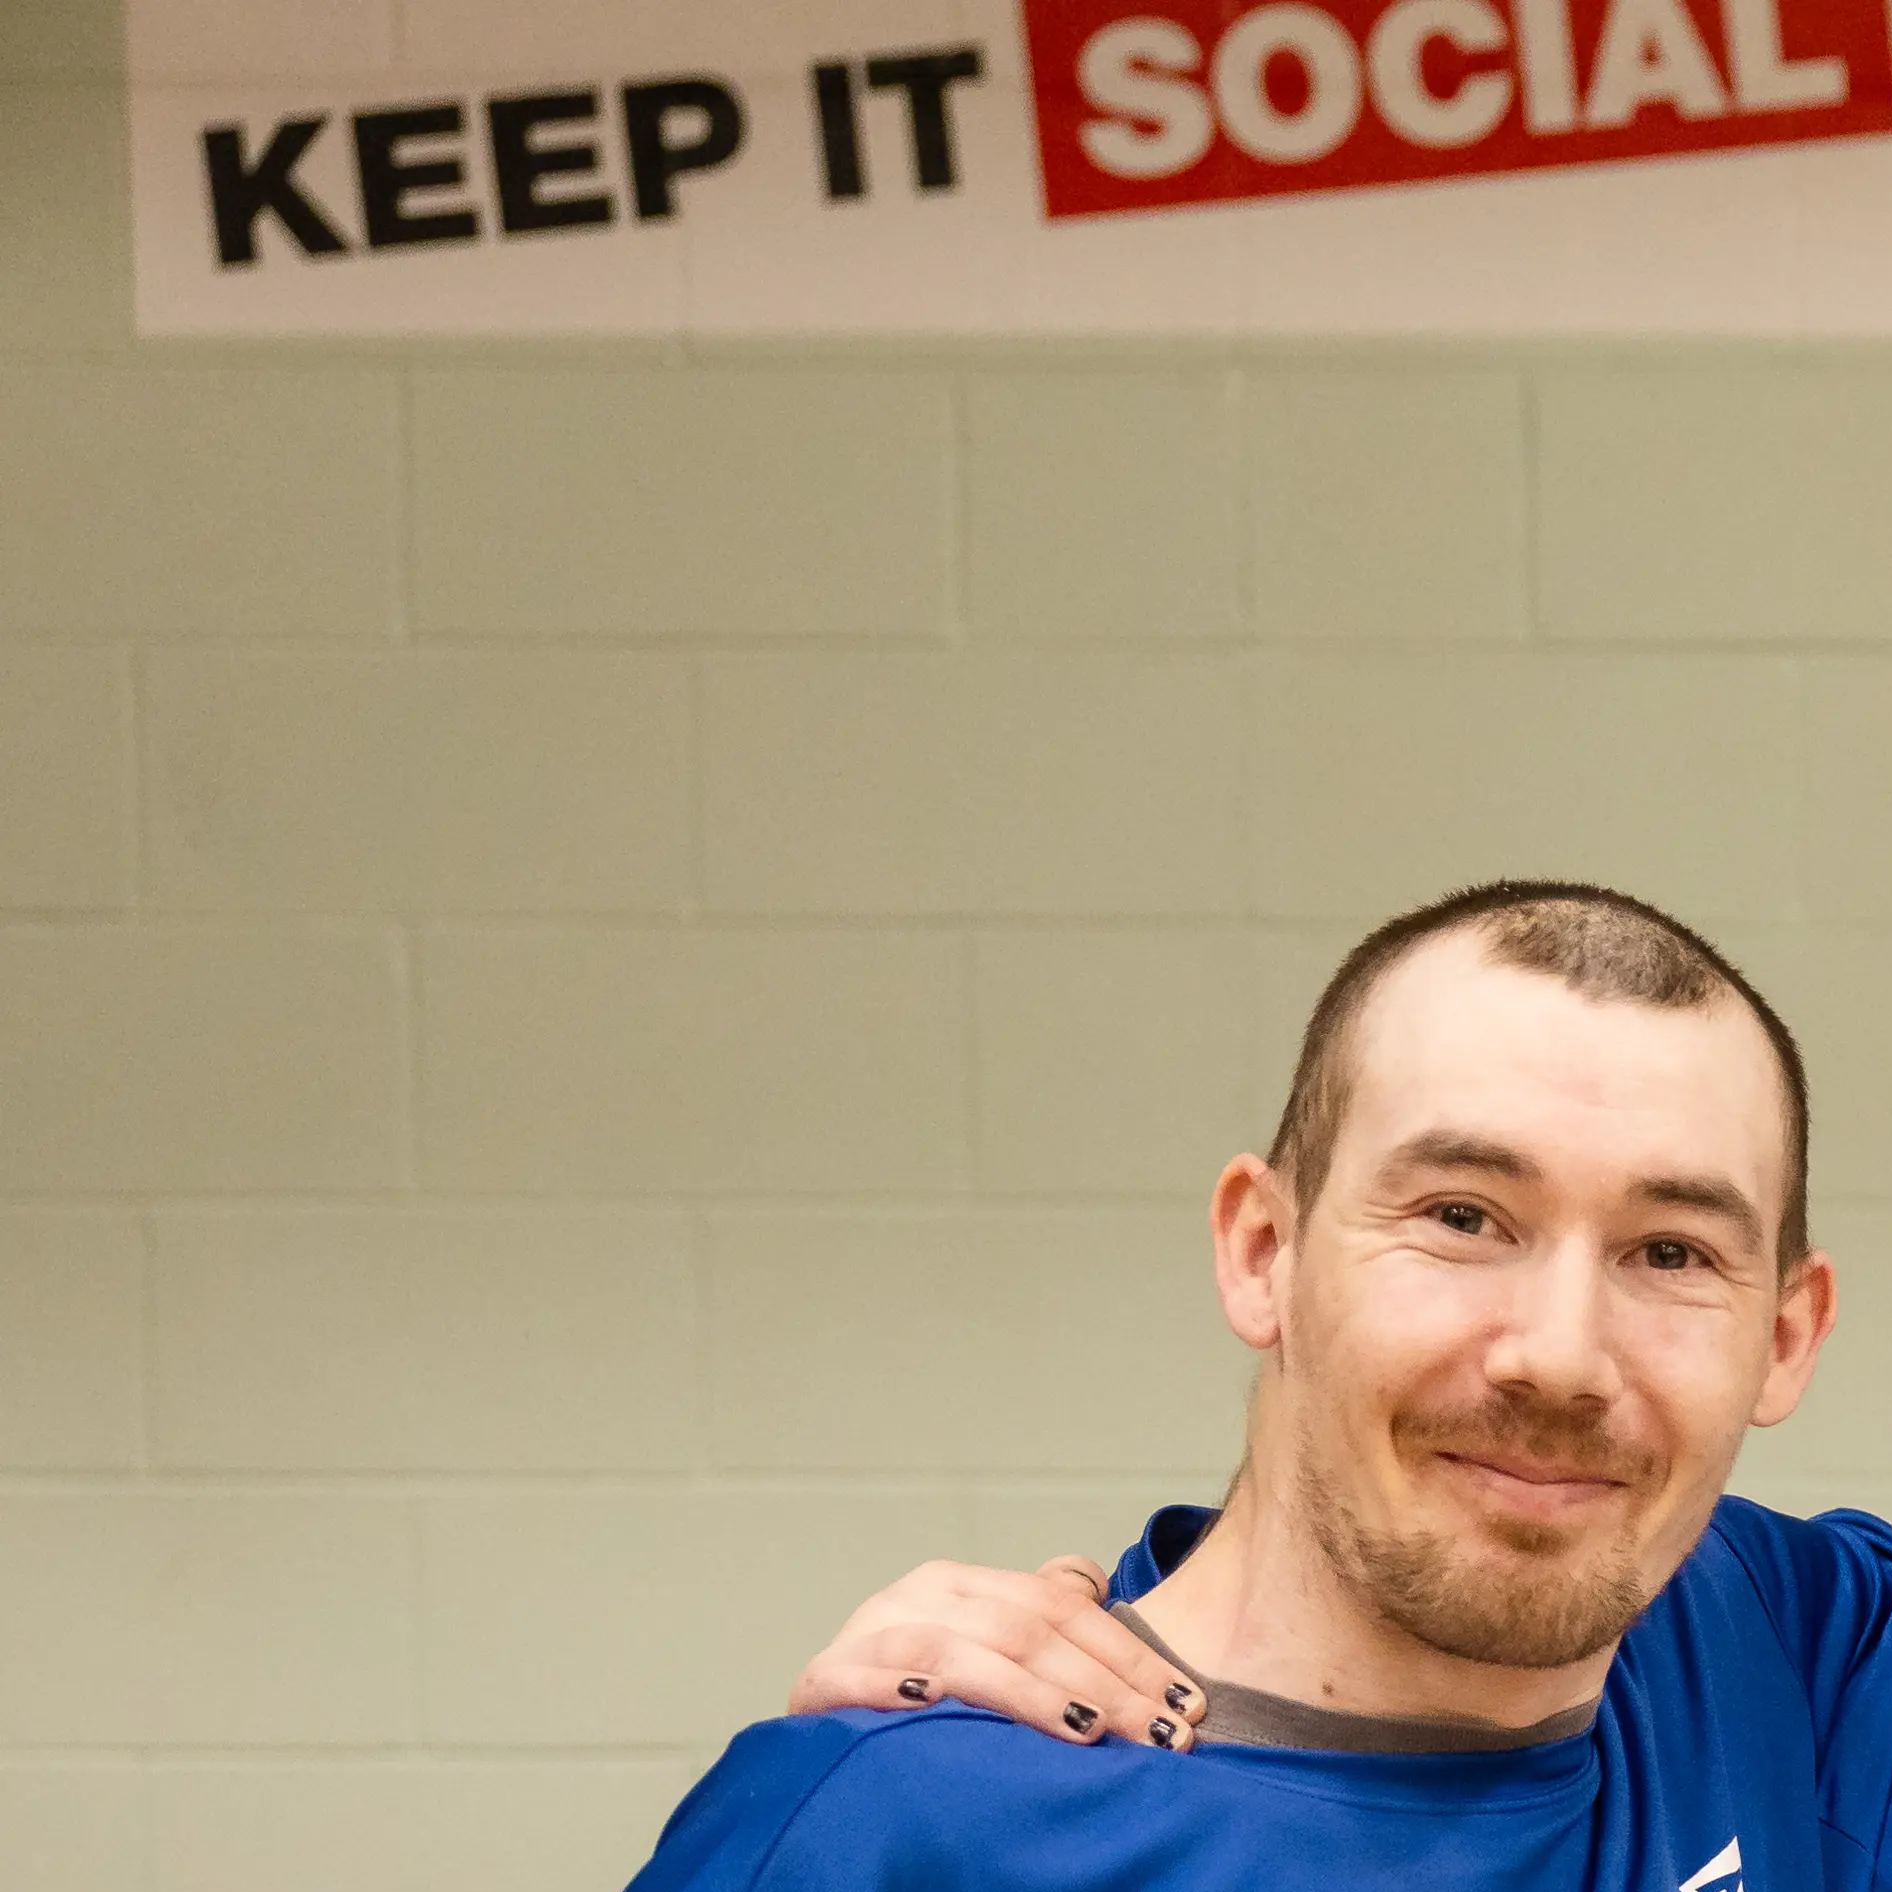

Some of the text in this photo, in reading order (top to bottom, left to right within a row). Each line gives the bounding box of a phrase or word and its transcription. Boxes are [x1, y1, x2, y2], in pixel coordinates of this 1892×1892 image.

[203, 70, 748, 267] KEEP
[811, 48, 983, 200] IT
[1074, 0, 1852, 181] SOCIAL
